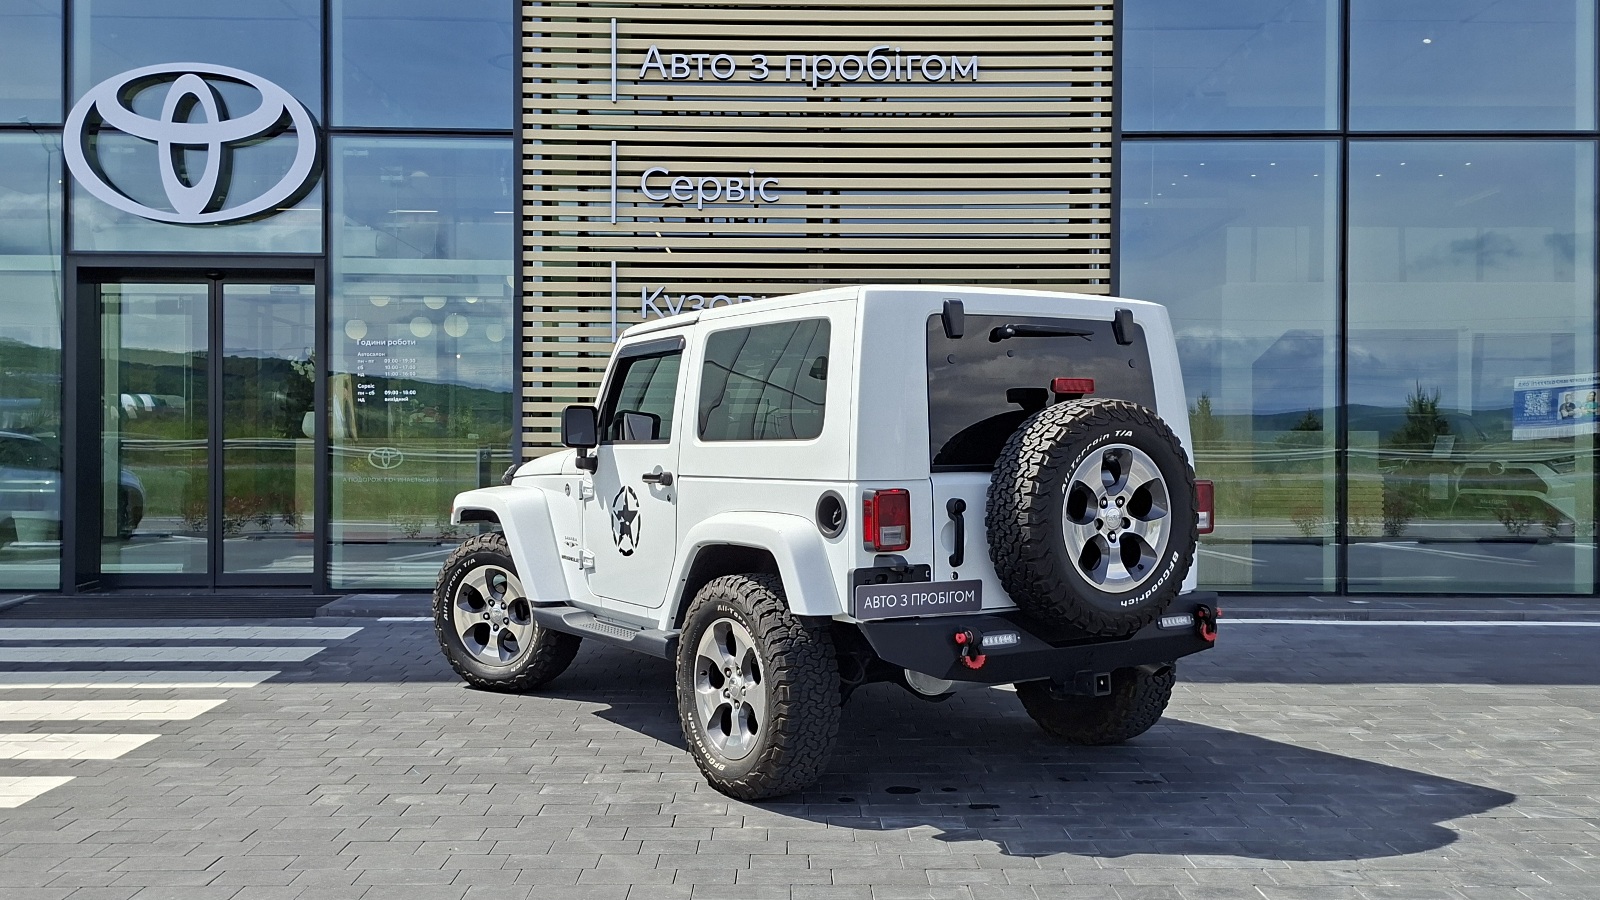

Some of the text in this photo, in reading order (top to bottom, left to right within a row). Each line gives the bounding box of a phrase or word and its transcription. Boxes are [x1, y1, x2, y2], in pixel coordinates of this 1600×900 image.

[639, 45, 979, 89] Авто з пробігом
[640, 166, 780, 210] Сервіс
[357, 339, 416, 347] Години роботи
[443, 558, 476, 621] All-Terrain T/A
[864, 590, 975, 609] АВТО З ПРОБІГОМ
[1120, 551, 1179, 607] BFGoodrich
